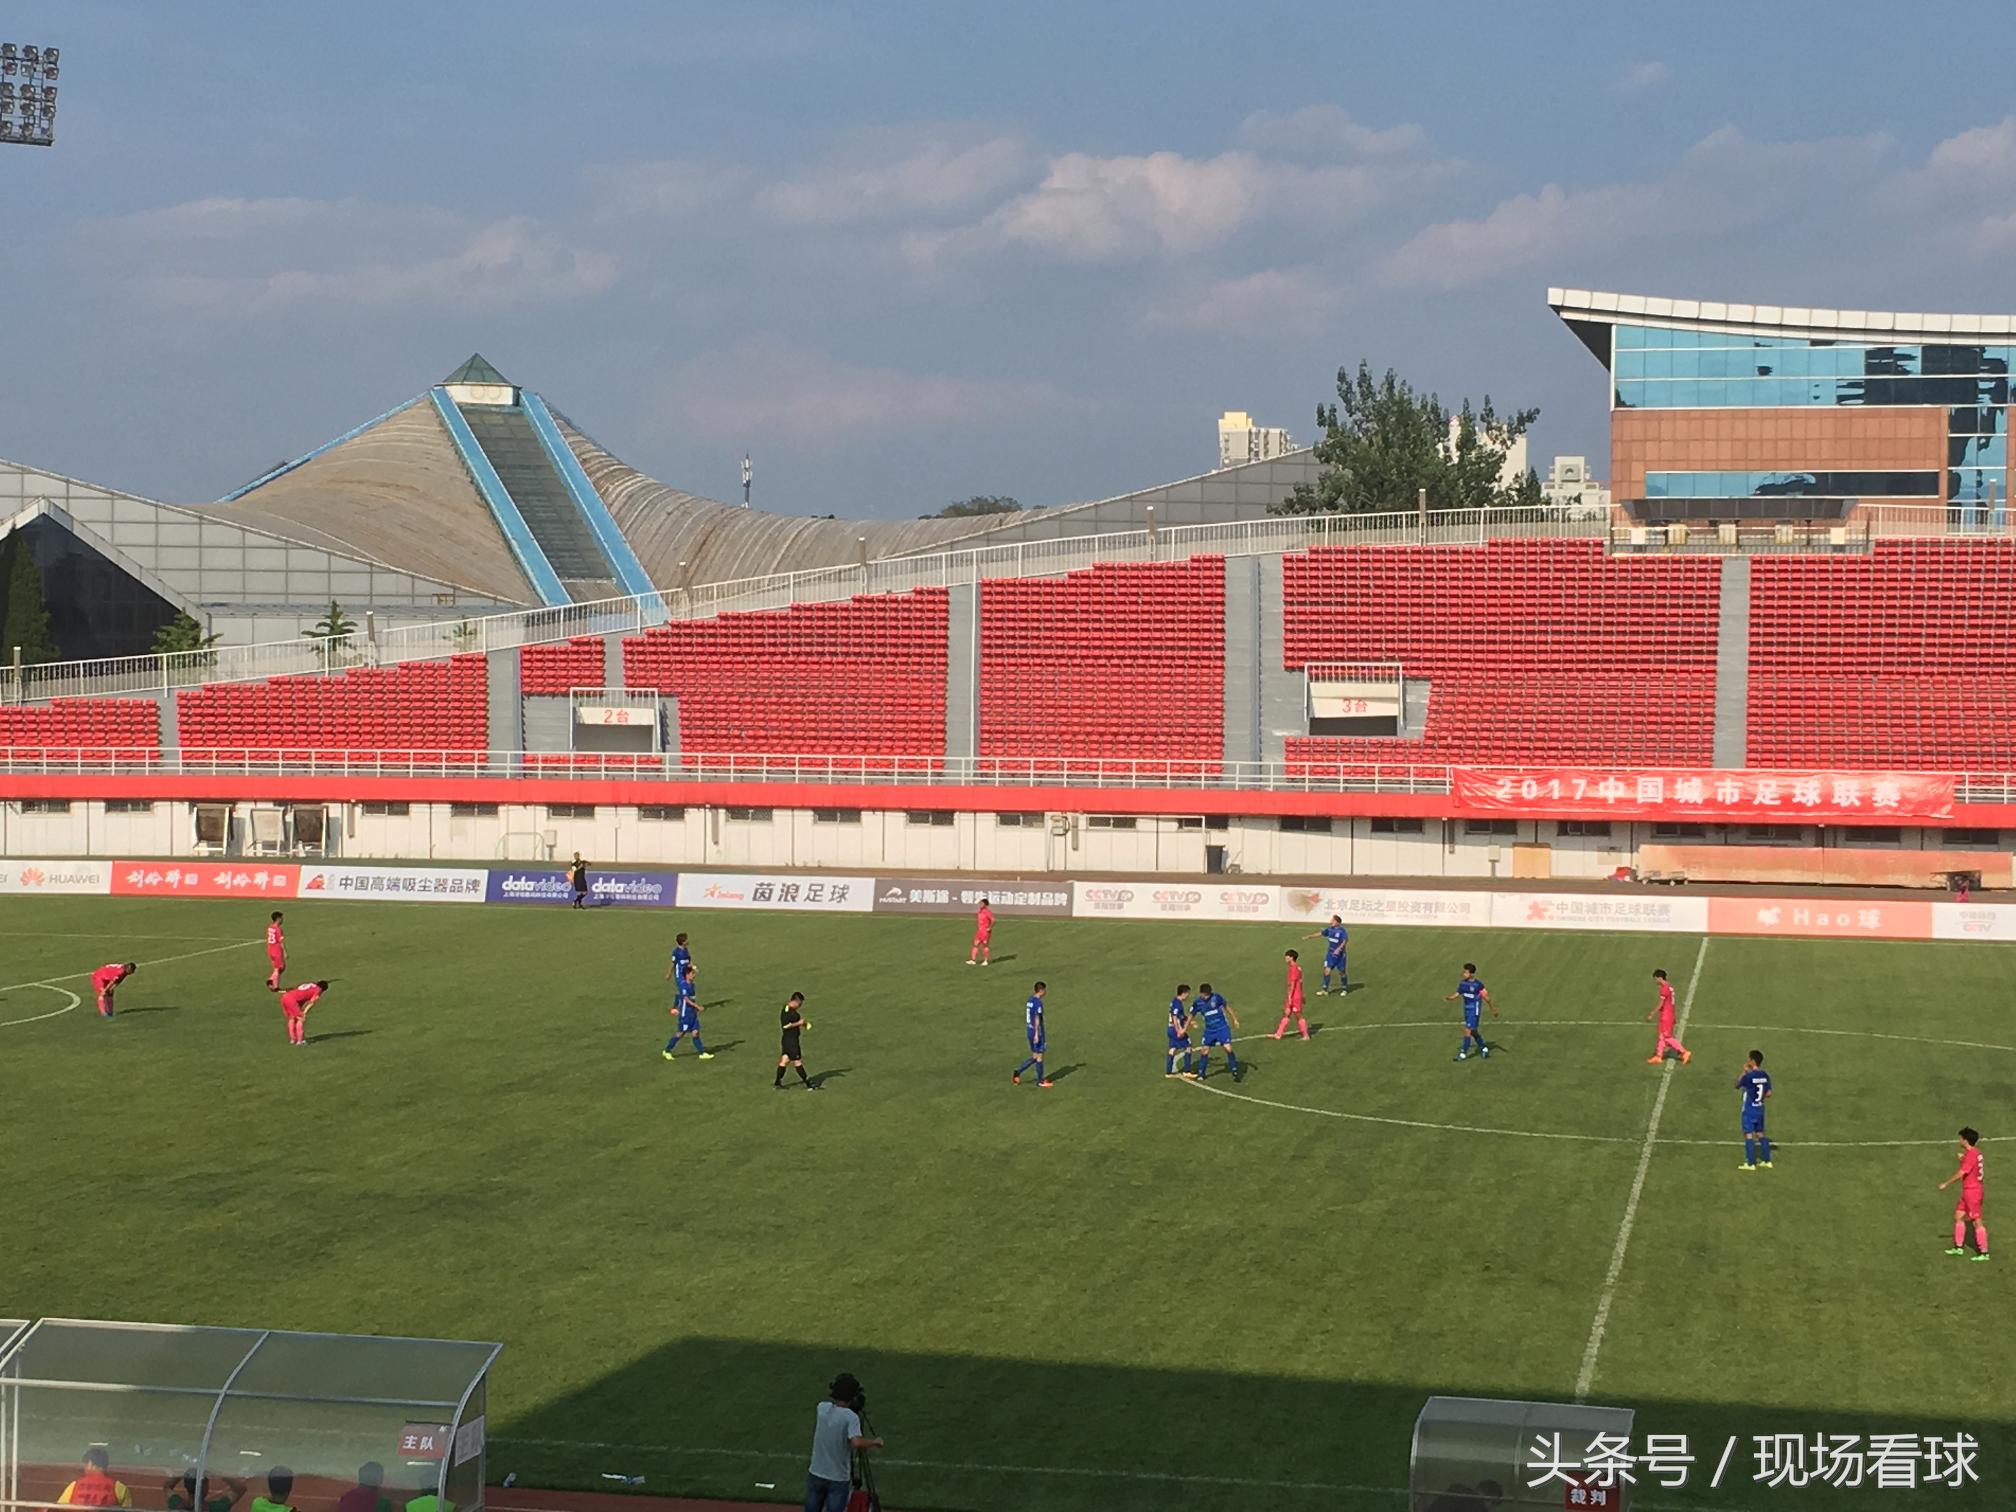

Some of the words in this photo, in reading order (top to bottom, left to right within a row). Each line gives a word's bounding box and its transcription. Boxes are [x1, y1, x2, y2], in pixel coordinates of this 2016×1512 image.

[604, 709, 629, 723] 2台
[1496, 776, 1902, 808] 2017中国城市足球联赛
[49, 874, 100, 884] HUAWEI
[339, 875, 481, 894] 中国高端吸尘器品牌
[502, 875, 572, 892] datavideo
[591, 877, 663, 894] datavideo
[752, 882, 850, 903] 茵浪足球
[1556, 901, 1671, 916] 中国城市足球联赛
[403, 1435, 433, 1450] 主队
[1570, 1488, 1607, 1506] 裁判
